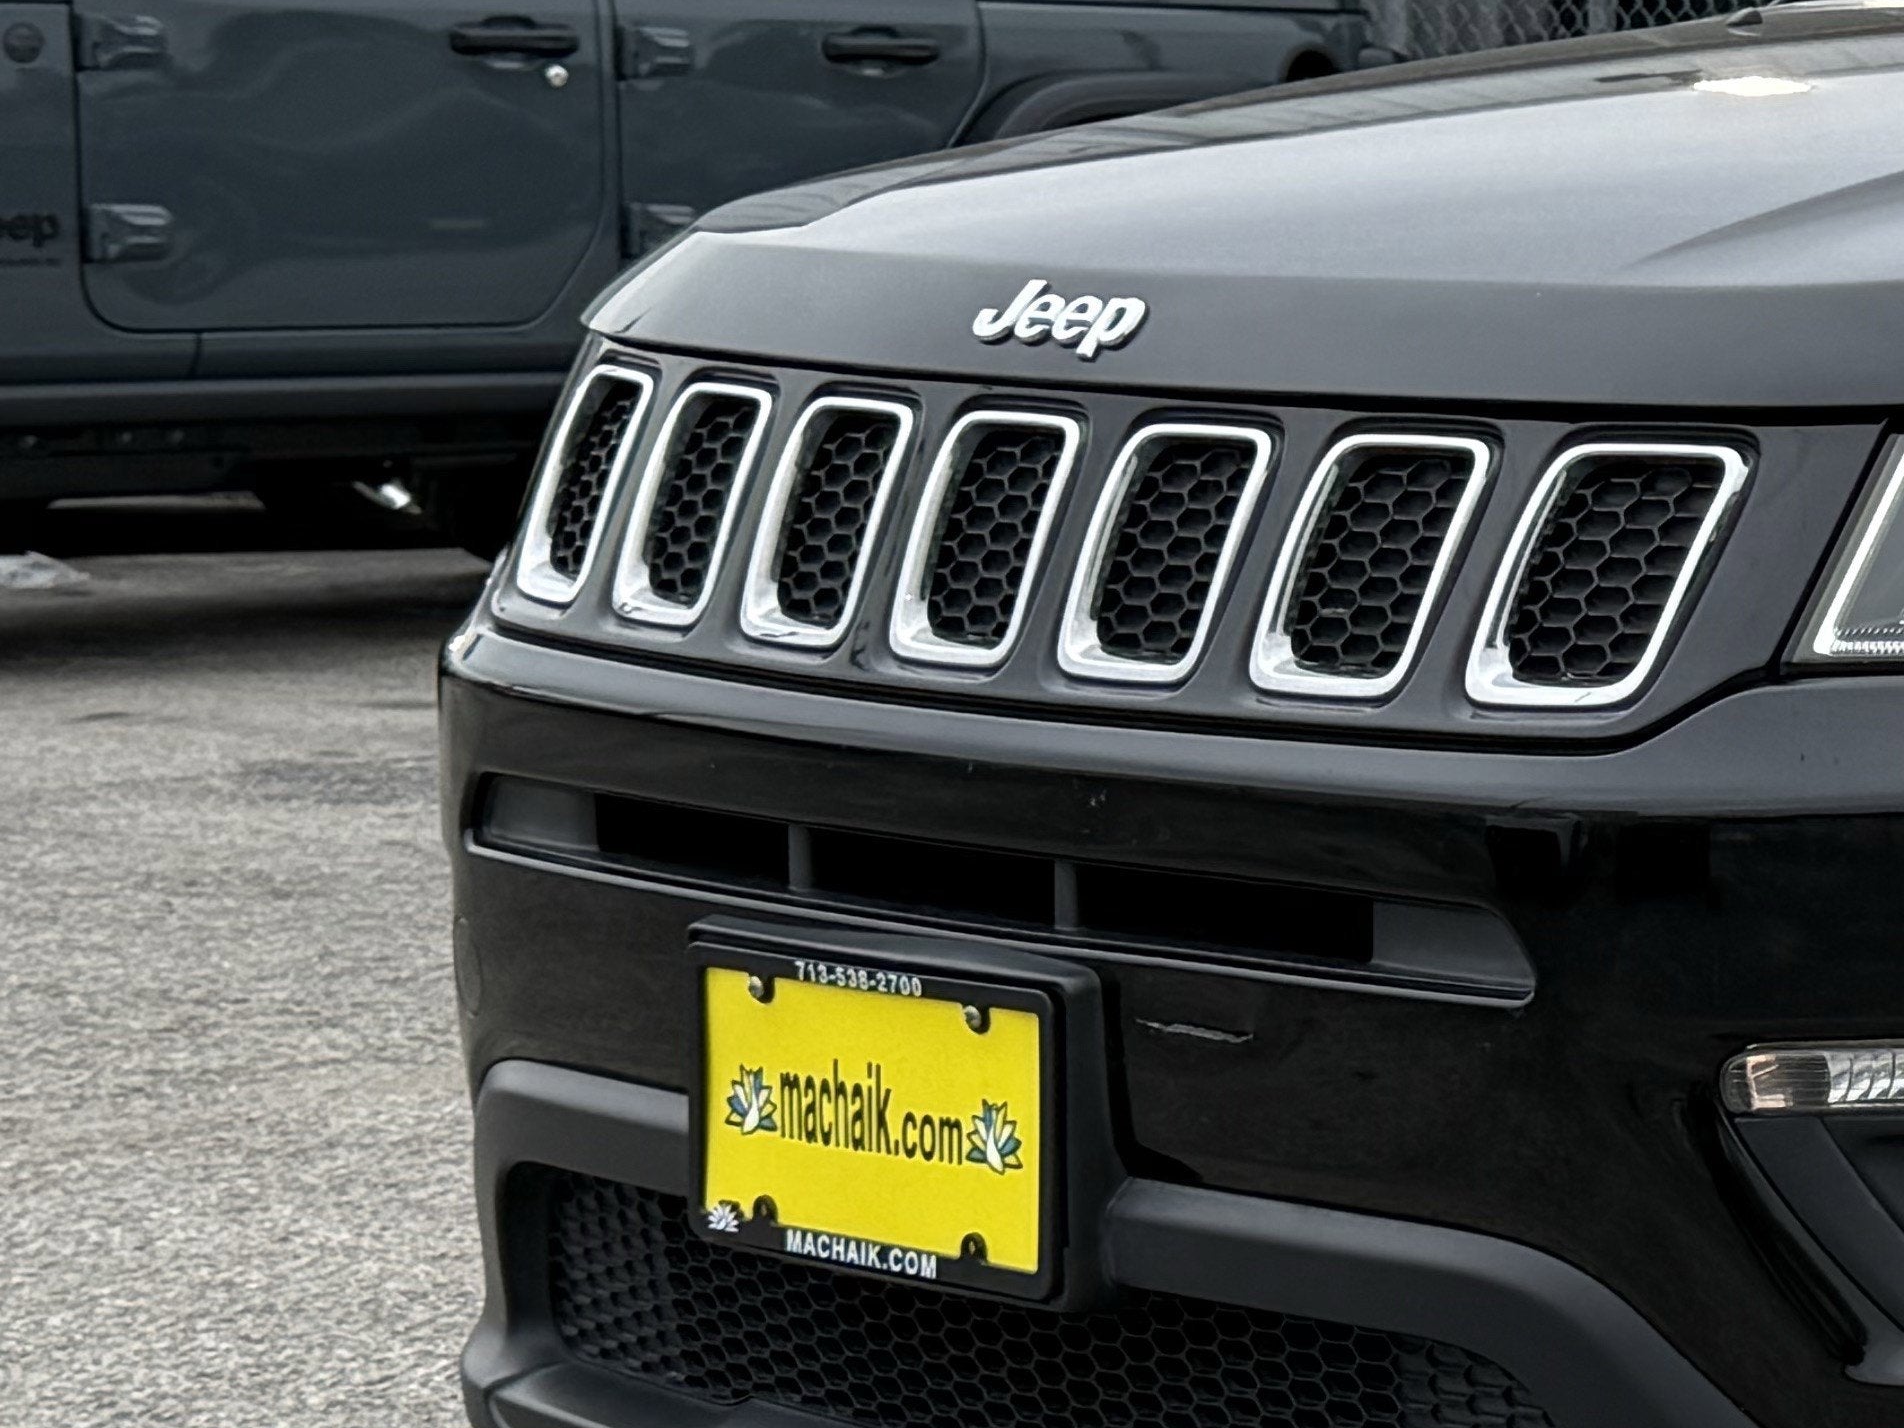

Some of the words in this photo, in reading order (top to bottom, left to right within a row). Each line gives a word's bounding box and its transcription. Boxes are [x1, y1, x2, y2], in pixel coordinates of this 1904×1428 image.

[972, 279, 1147, 360] Jeep
[795, 960, 922, 997] 713-538-2700
[780, 1060, 963, 1166] machaik.com
[787, 1229, 937, 1278] MACHAIK.COM
